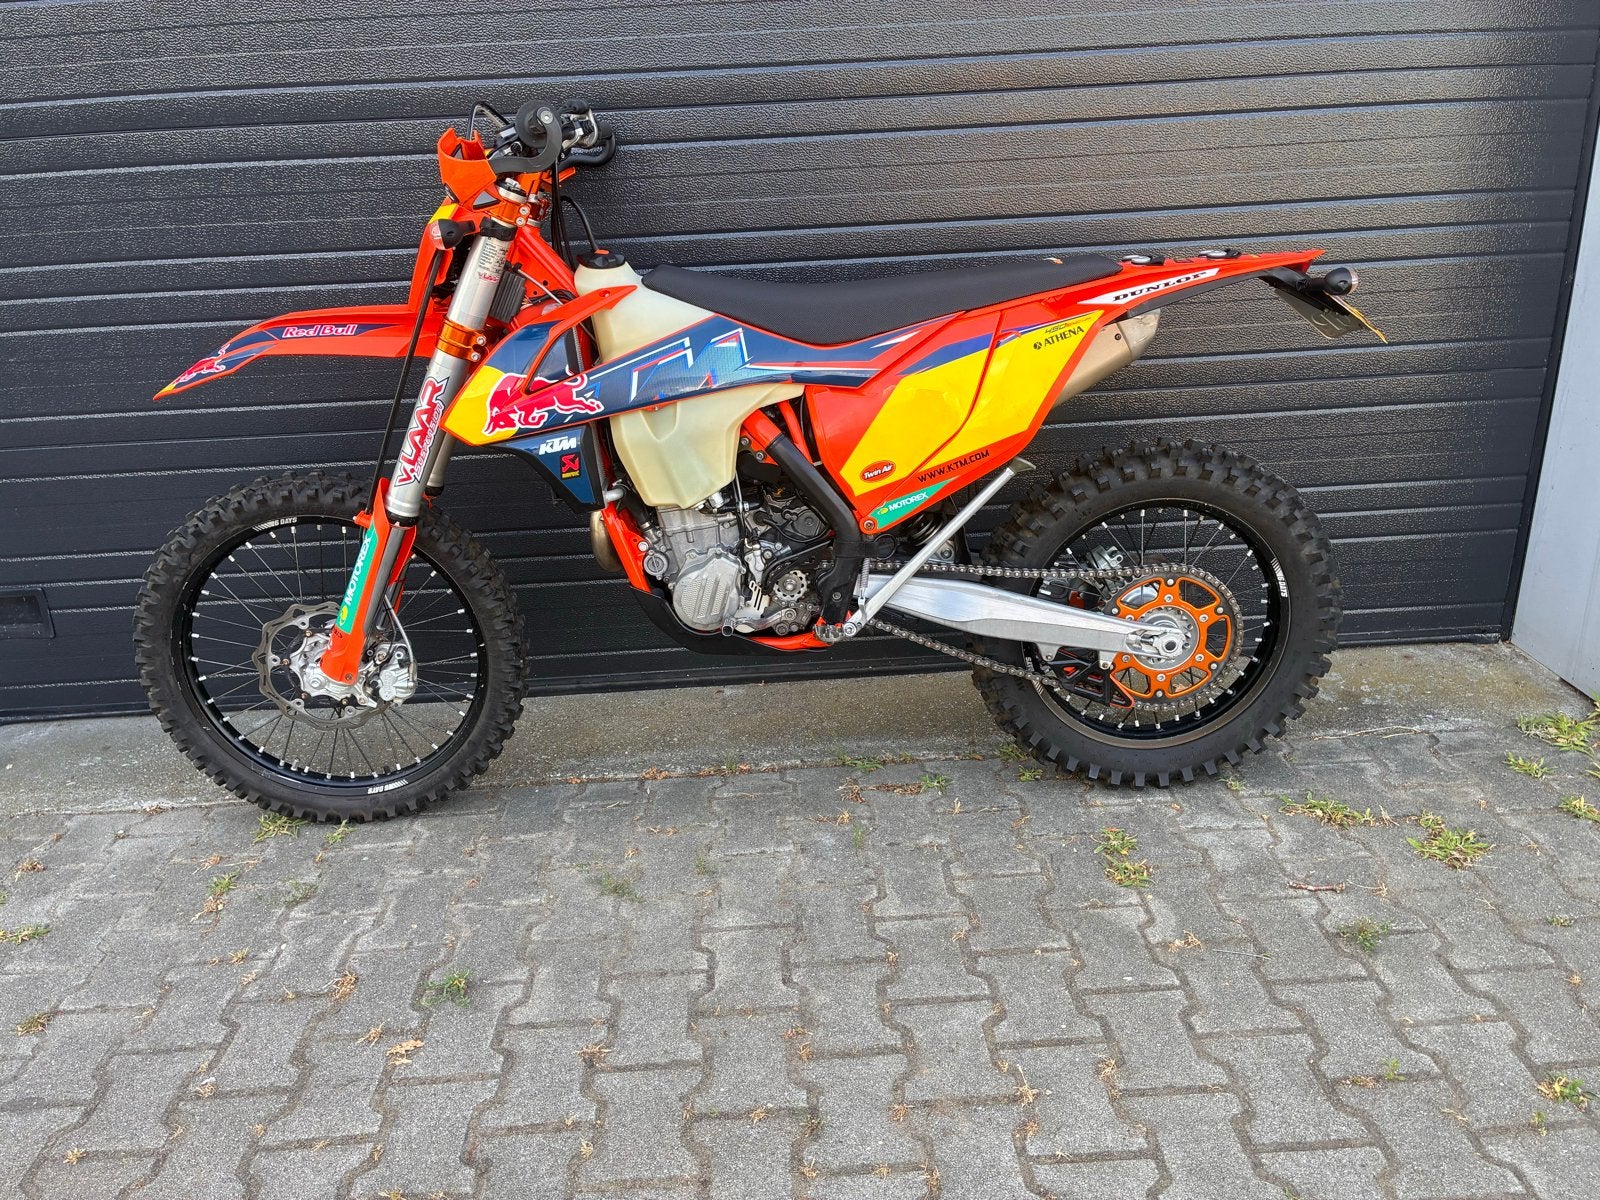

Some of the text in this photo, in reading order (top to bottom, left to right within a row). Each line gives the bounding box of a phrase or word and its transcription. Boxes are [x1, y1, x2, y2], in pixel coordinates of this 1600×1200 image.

[282, 324, 358, 338] Red Bull
[1044, 326, 1084, 347] ATHENA
[538, 436, 577, 455] KTM
[864, 464, 893, 479] Twin Air
[917, 450, 990, 483] WWW.KTM.COM
[888, 492, 929, 512] MOTOREX
[280, 517, 298, 525] DAYS
[345, 534, 372, 606] MOTOREX
[1279, 581, 1288, 598] DAYS
